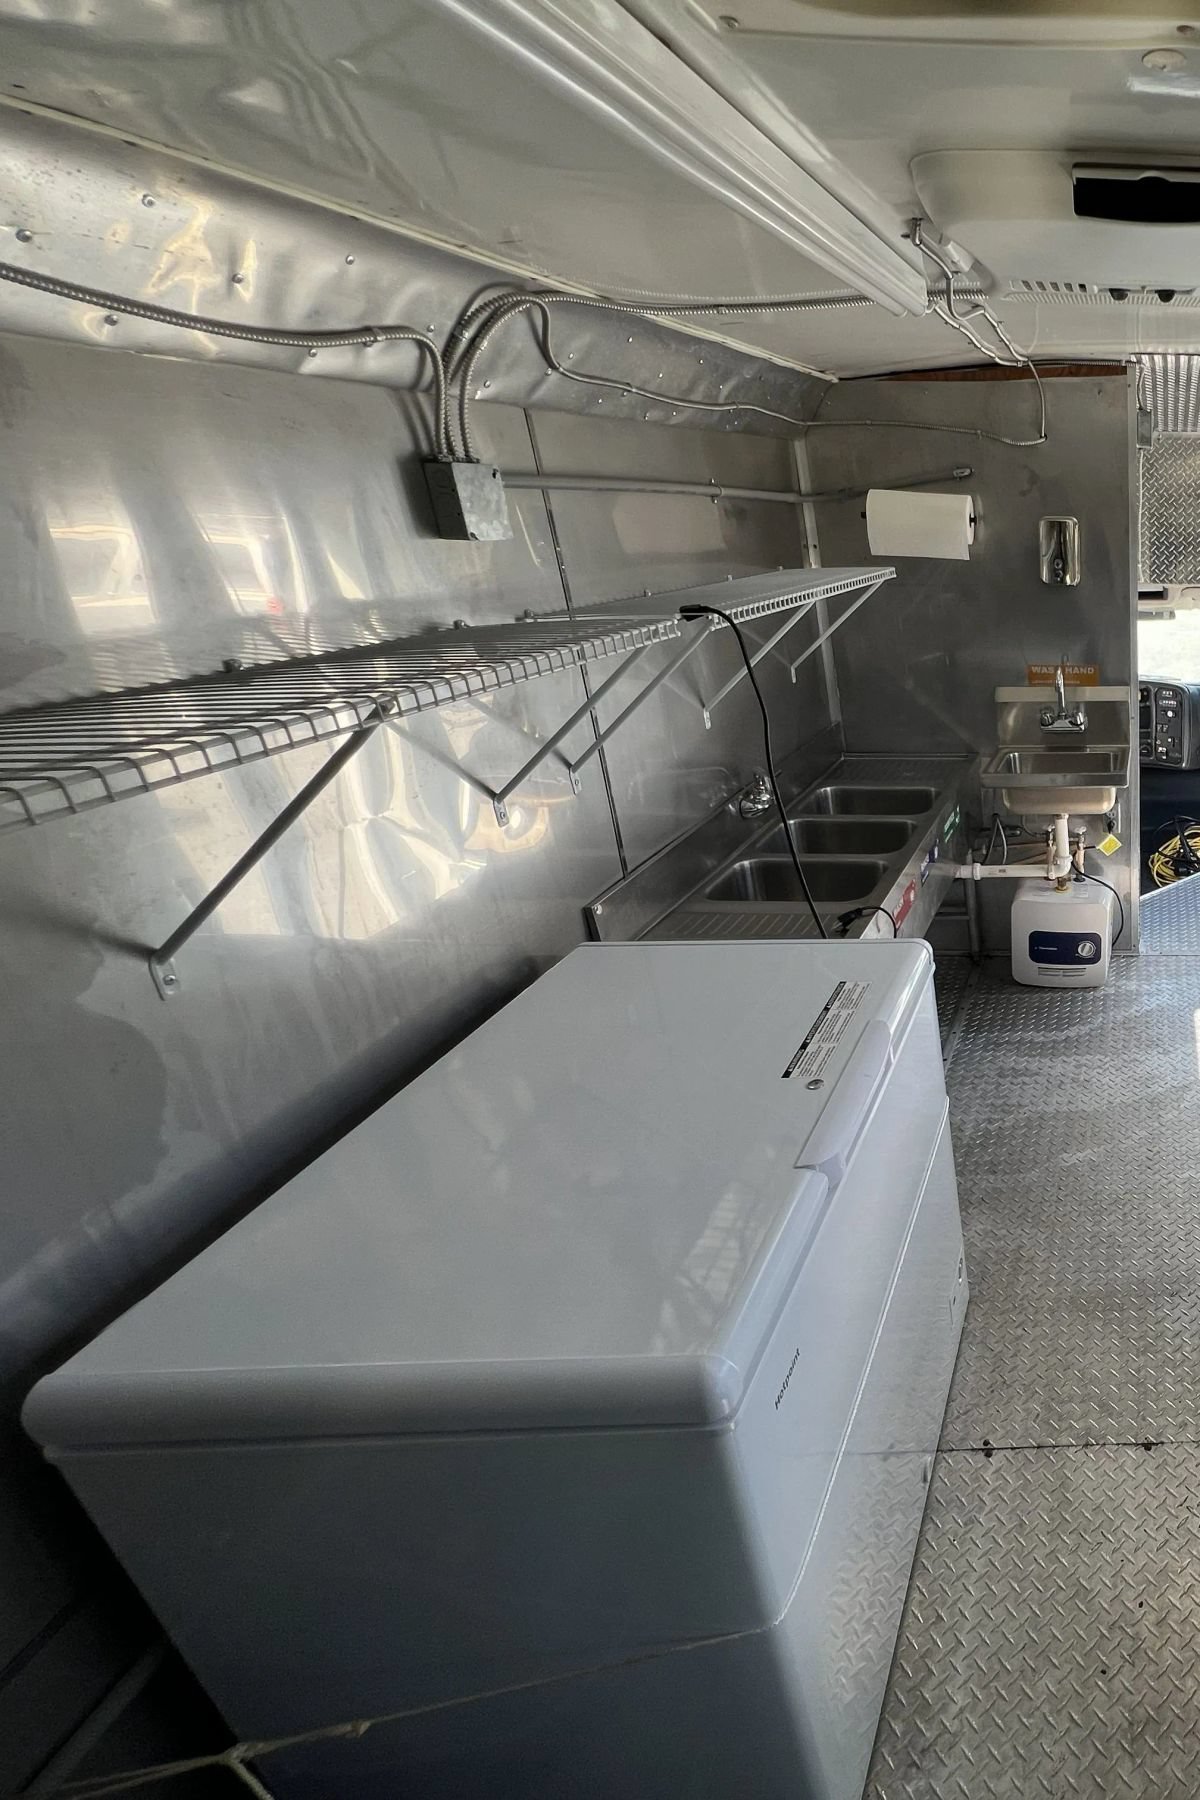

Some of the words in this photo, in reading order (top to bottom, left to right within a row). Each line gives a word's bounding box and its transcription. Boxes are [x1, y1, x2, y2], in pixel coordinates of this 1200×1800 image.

[1031, 666, 1057, 674] WAS
[1065, 666, 1094, 674] HAND
[774, 1348, 800, 1410] Hotpoint
